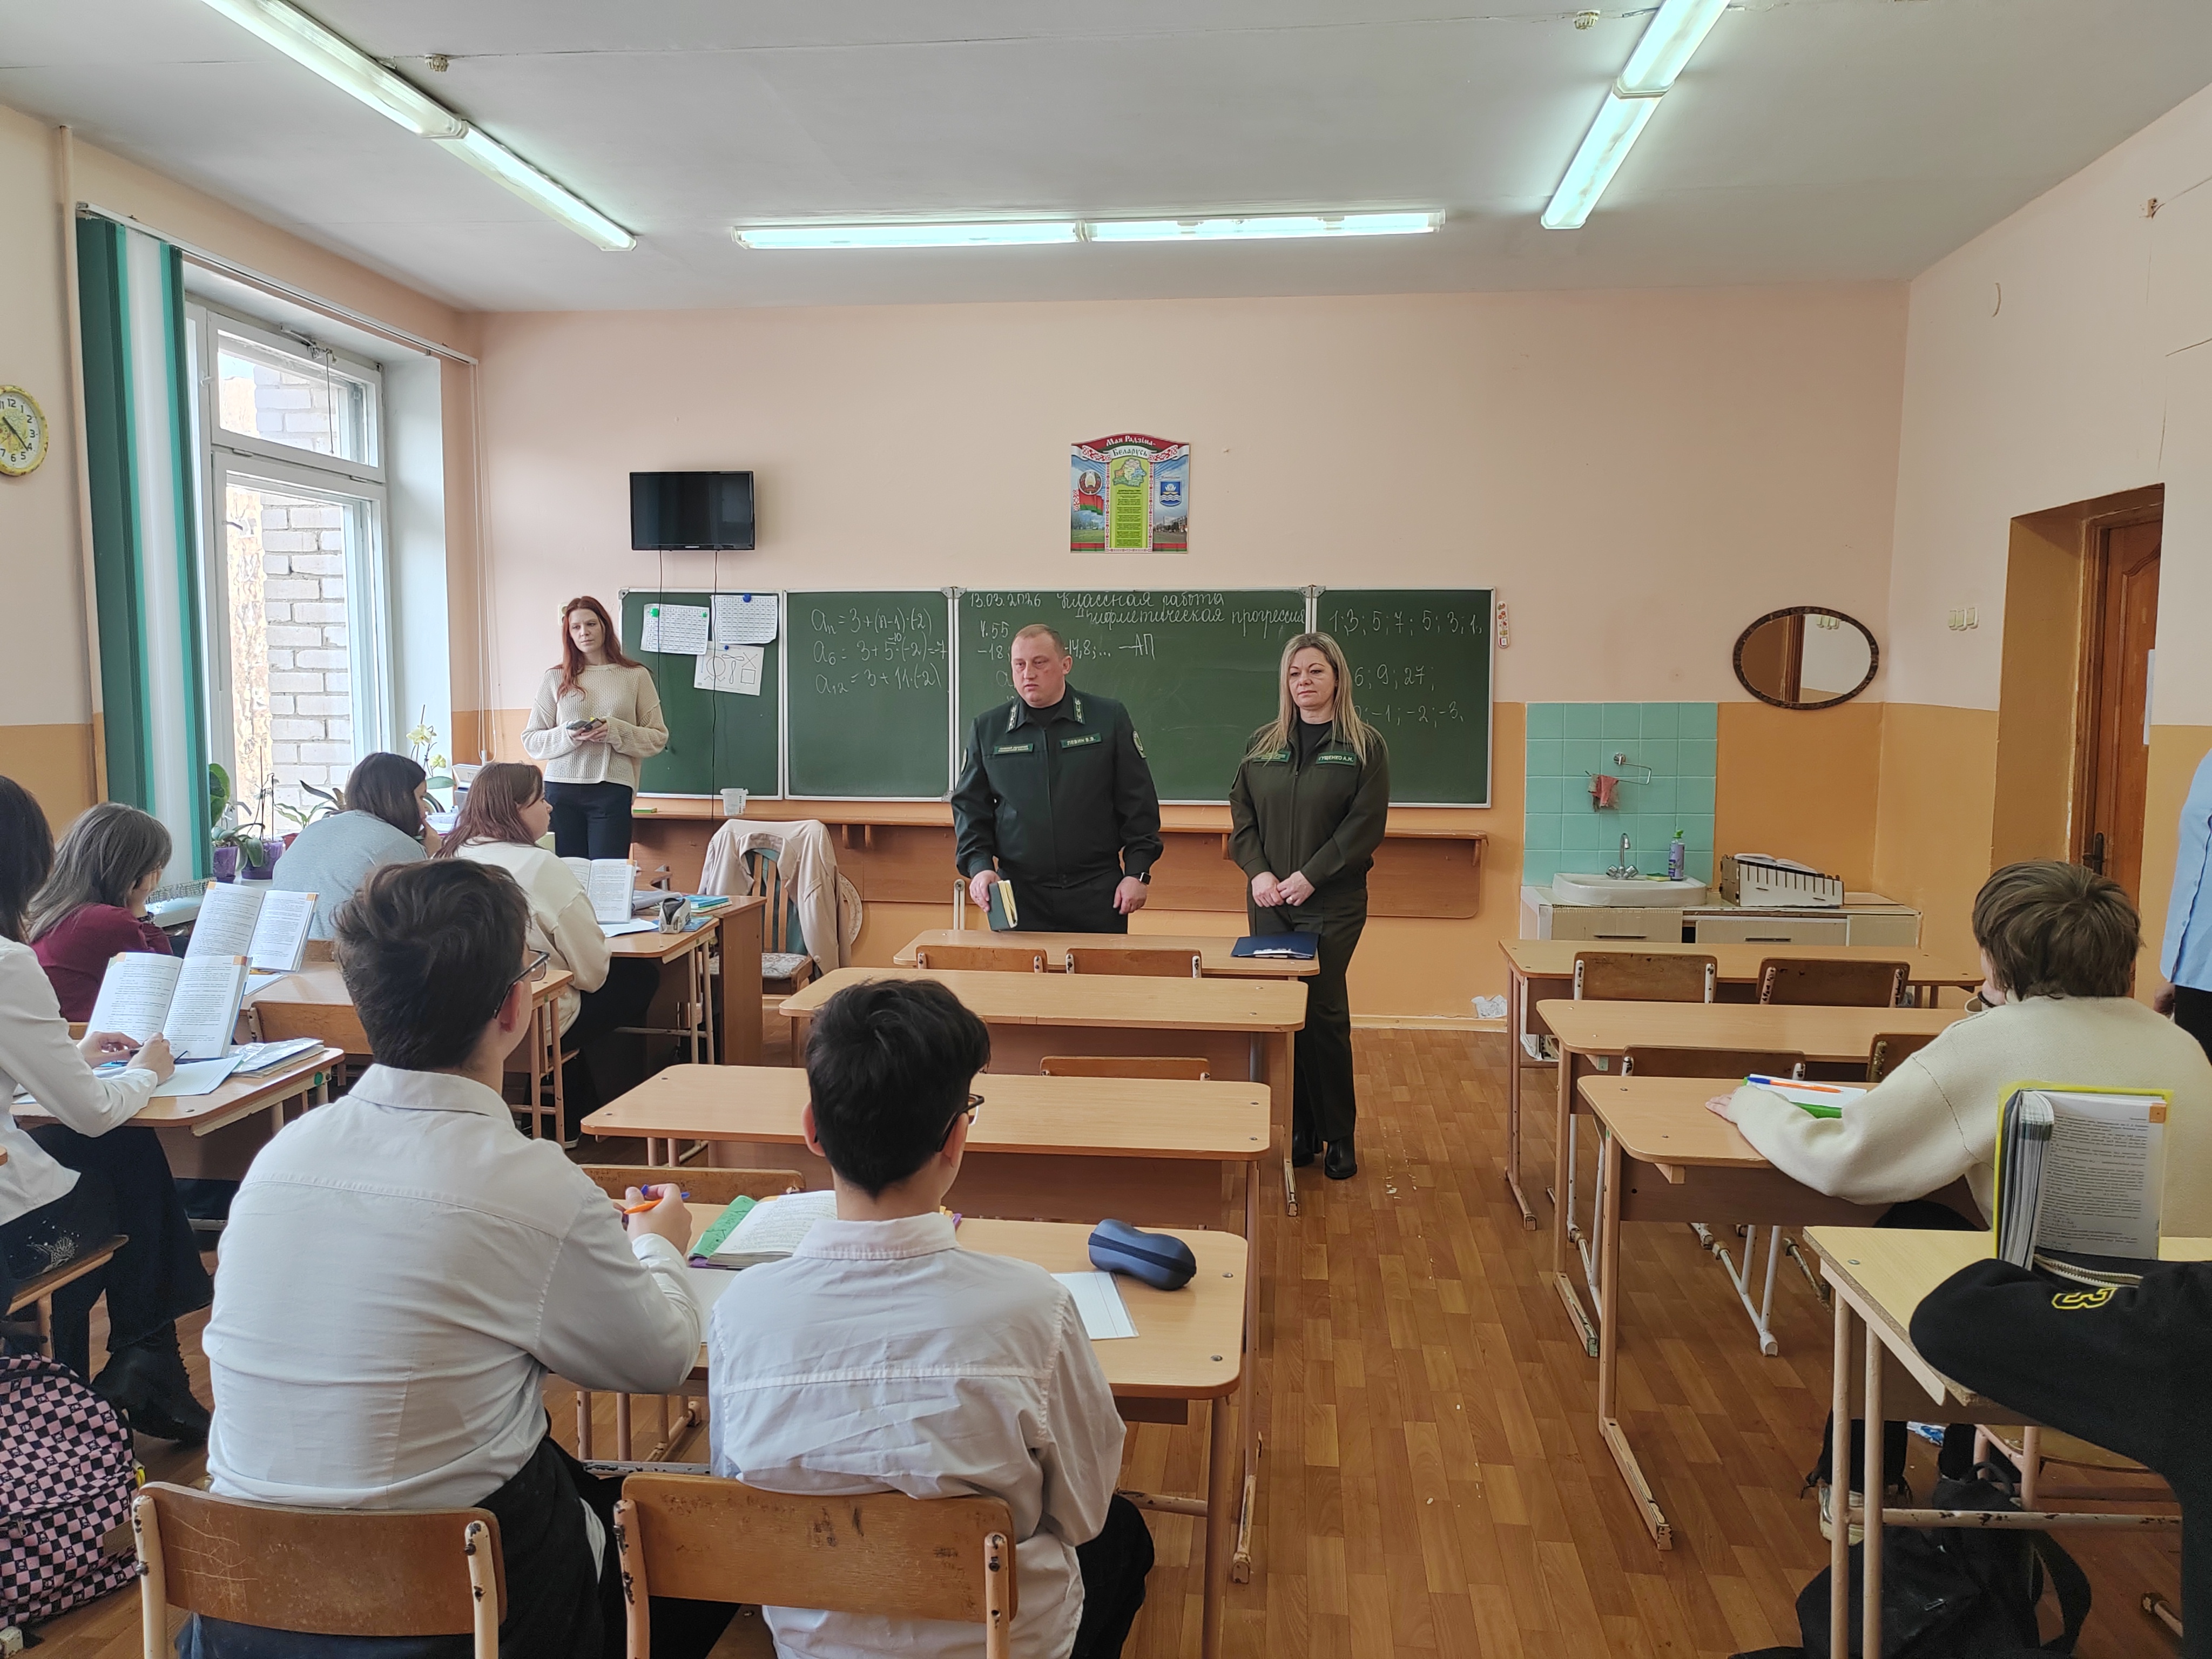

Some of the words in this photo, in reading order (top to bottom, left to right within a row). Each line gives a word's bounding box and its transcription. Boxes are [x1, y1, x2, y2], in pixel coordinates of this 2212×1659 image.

[8, 399, 16, 408] 12
[26, 415, 32, 423] 2
[30, 429, 35, 438] 3
[1106, 437, 1123, 447] Мая
[0, 448, 5, 457] 7
[21, 451, 26, 460] 5
[11, 454, 16, 462] 6
[1057, 591, 1154, 610] Классная
[1162, 591, 1224, 622] работа
[1231, 608, 1305, 639] прогрессия
